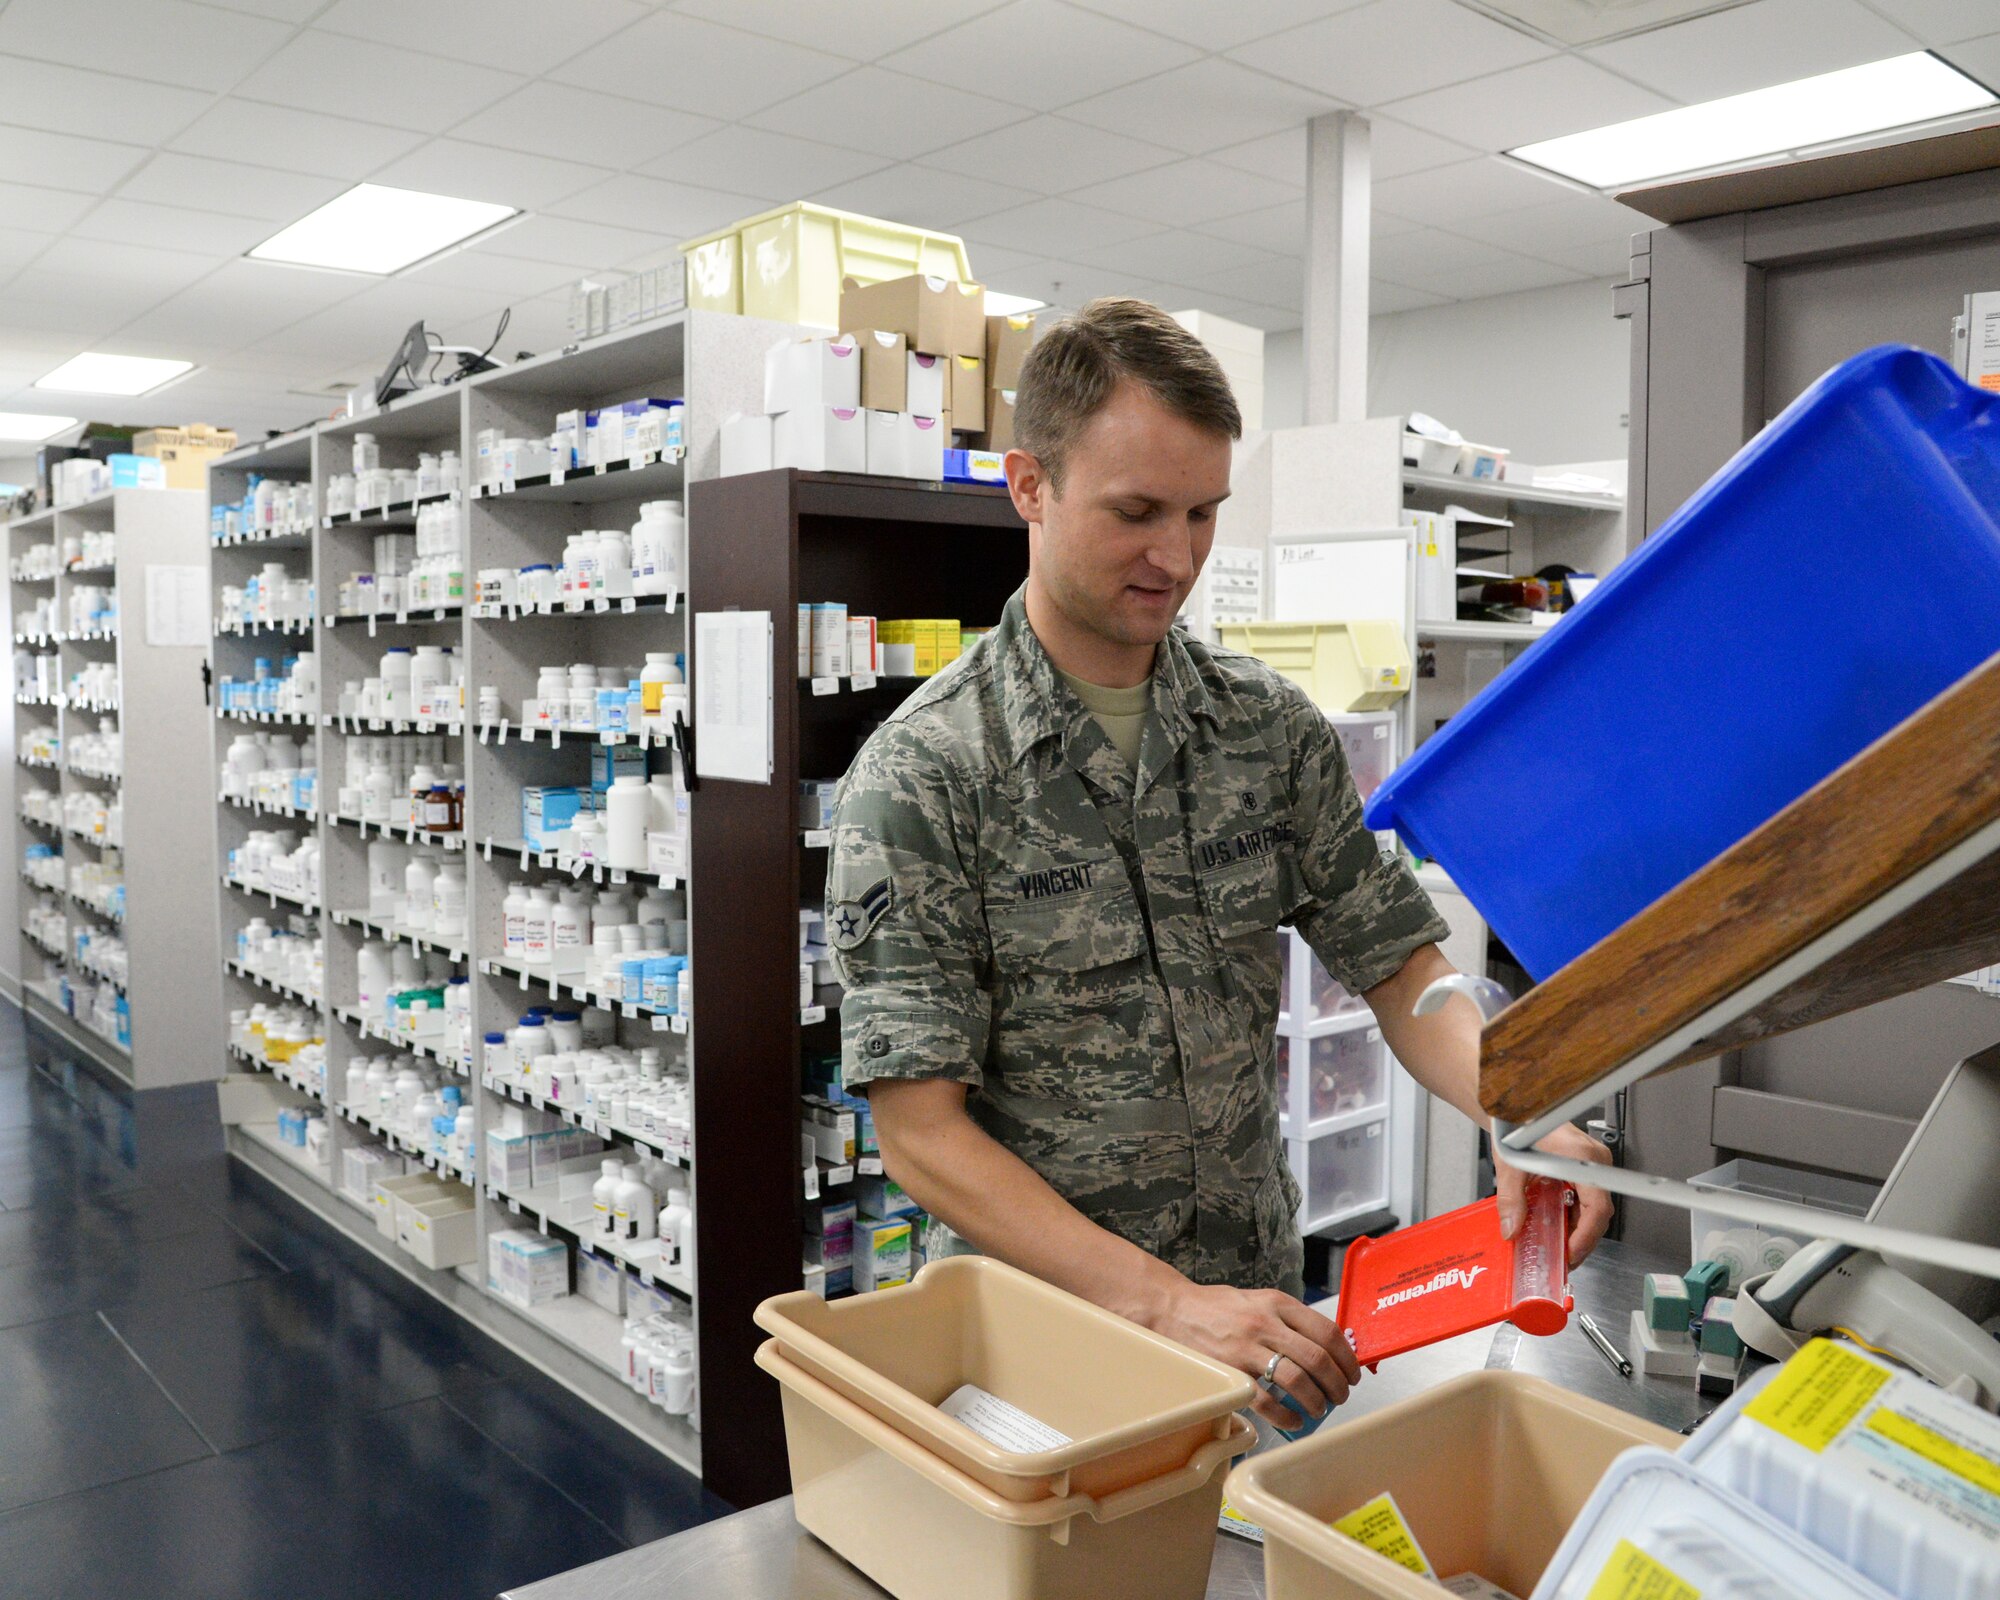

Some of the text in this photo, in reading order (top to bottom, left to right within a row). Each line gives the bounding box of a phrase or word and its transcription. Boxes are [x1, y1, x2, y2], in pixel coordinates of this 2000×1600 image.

[1202, 841, 1236, 868] U.S.
[1237, 831, 1263, 858] AIR
[1019, 861, 1092, 899] VINCENT
[1376, 1265, 1488, 1312] Aggrenox
